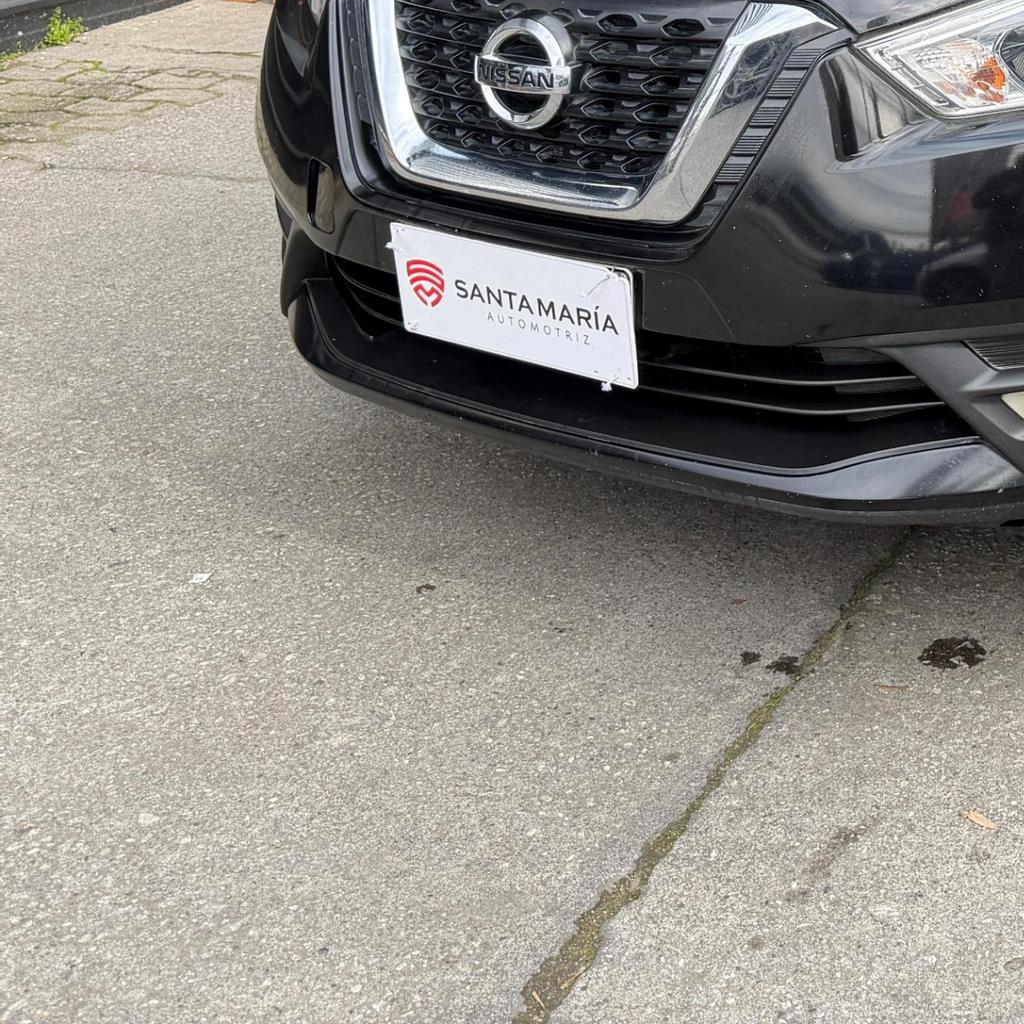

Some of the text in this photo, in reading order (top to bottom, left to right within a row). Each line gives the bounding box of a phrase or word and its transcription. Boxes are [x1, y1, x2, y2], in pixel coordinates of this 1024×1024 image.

[480, 64, 555, 89] NISSAN
[454, 279, 620, 336] SANTAMARÍA
[486, 311, 592, 346] AUTOMOTRIZ
